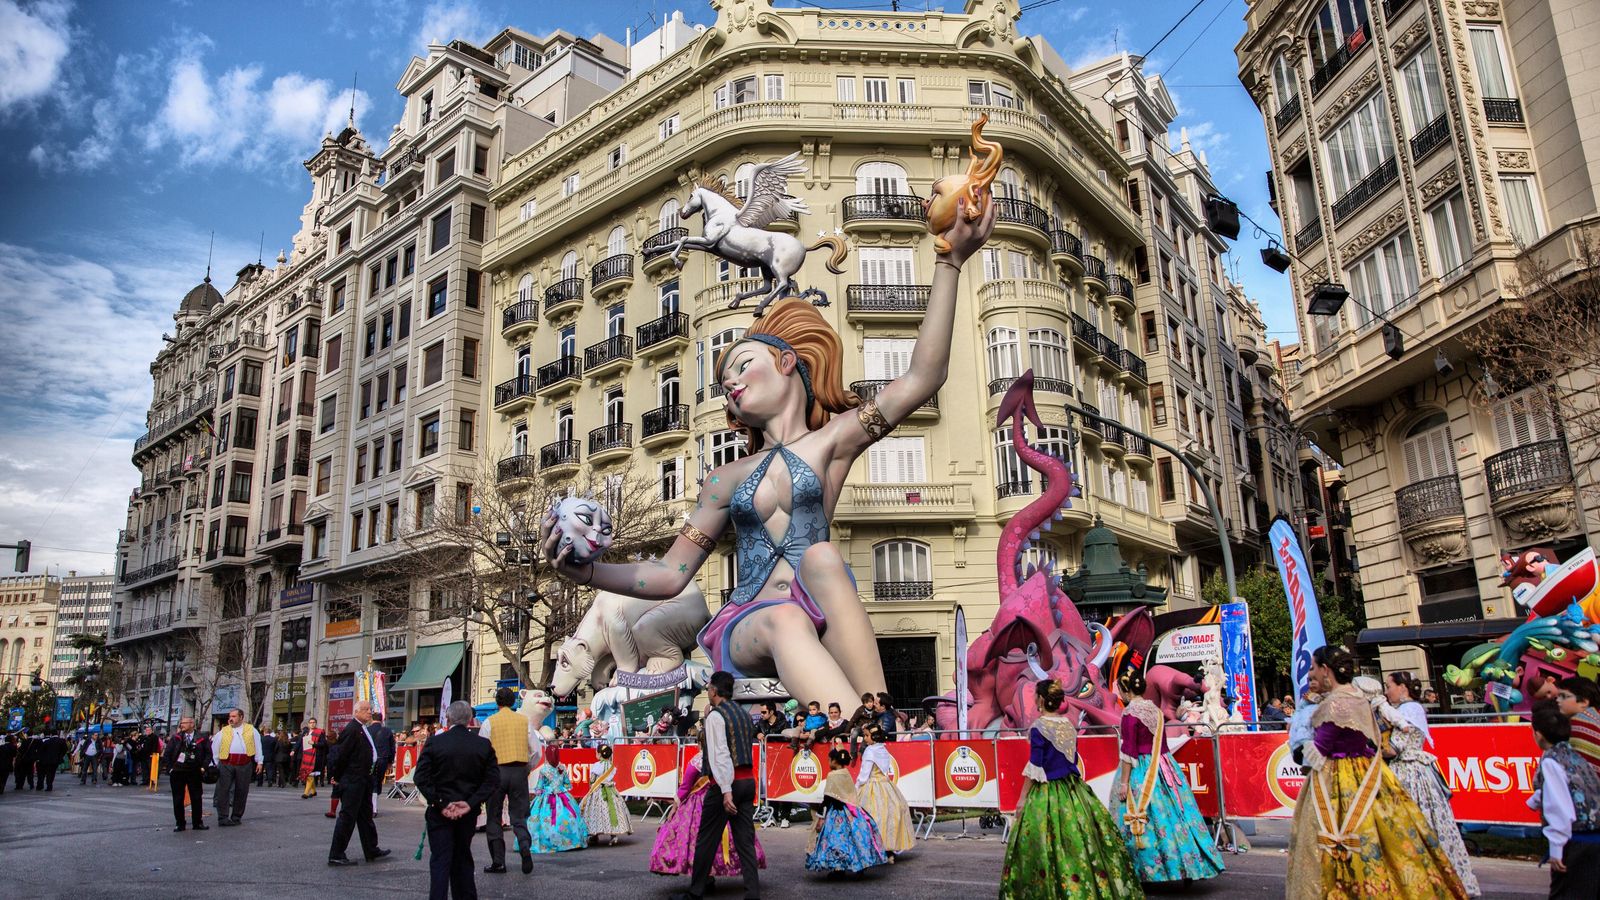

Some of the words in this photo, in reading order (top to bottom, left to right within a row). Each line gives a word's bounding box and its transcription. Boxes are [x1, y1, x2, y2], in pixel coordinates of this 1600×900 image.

[1178, 634, 1214, 645] TOPMADE
[618, 673, 641, 687] ESCUELA
[953, 766, 977, 774] AMSTEL
[1446, 756, 1541, 794] MST
